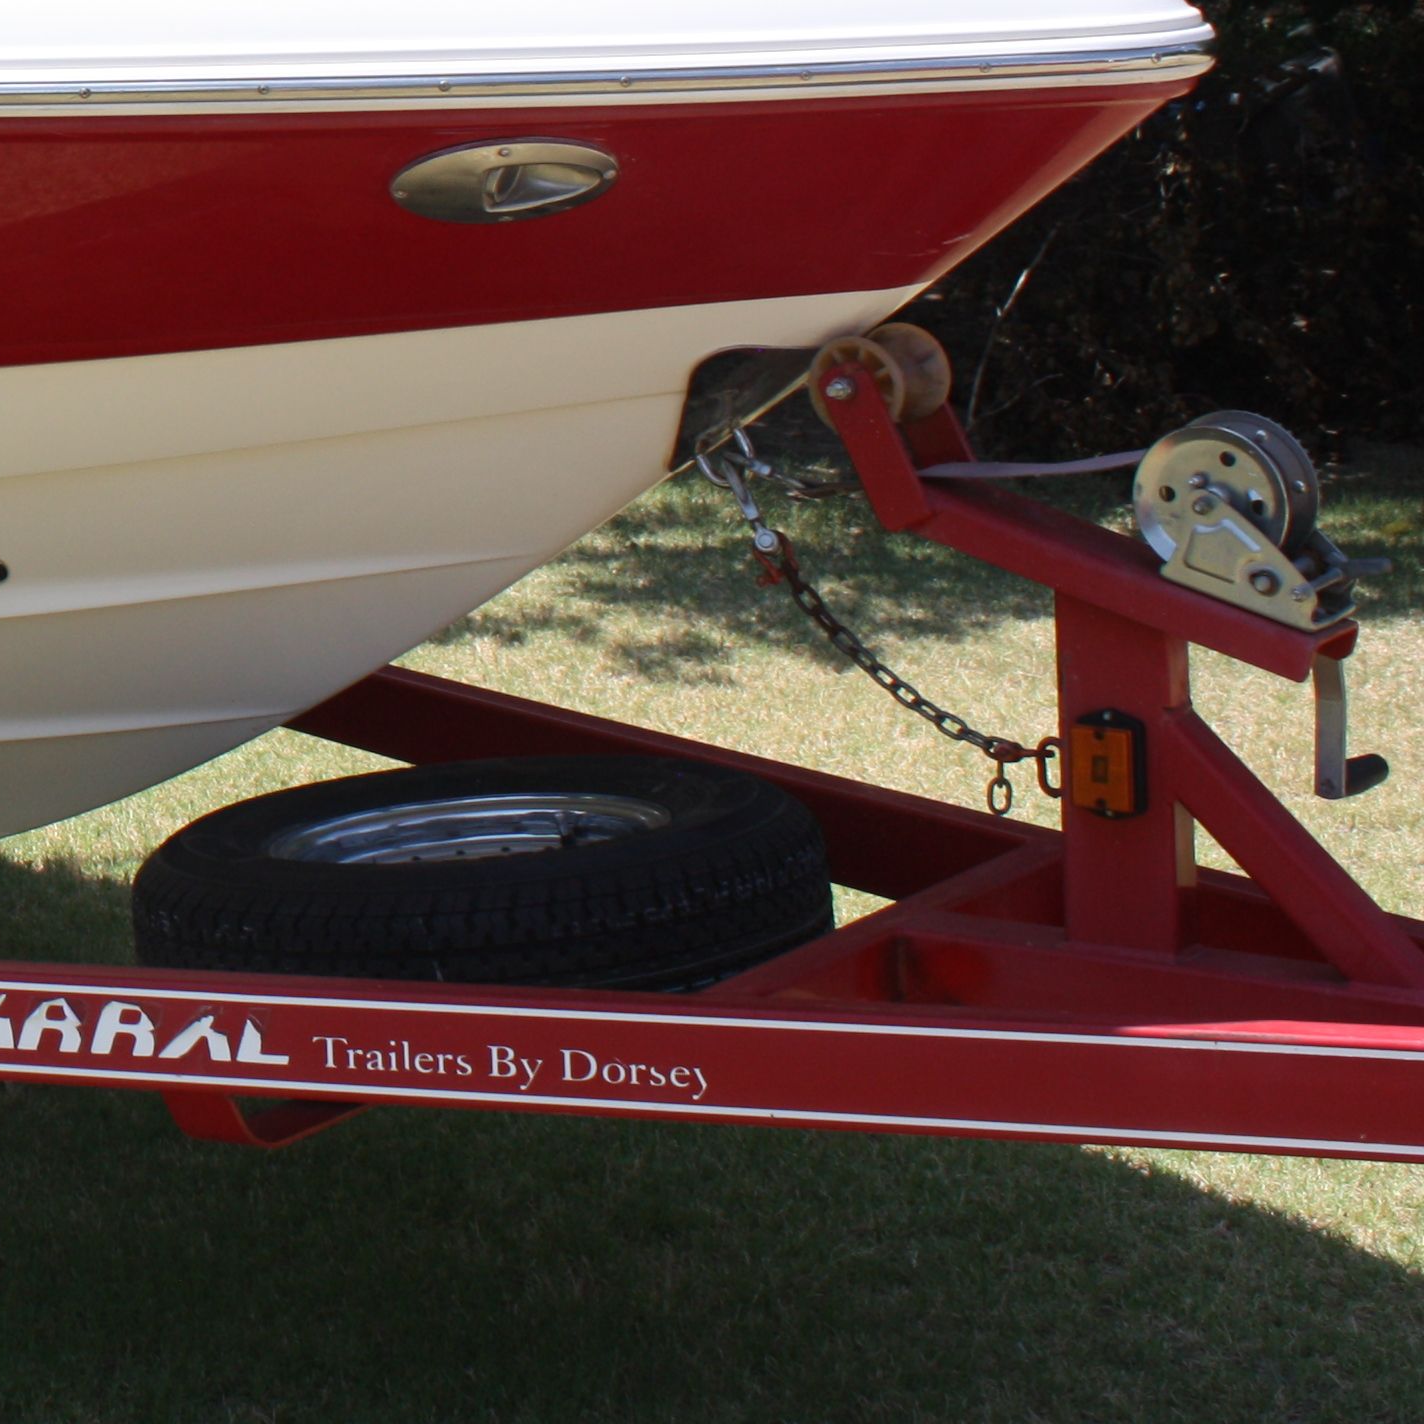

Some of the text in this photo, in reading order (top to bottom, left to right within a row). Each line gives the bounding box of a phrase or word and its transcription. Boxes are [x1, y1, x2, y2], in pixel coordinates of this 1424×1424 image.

[312, 1035, 472, 1077] Trailers
[487, 1045, 543, 1091] By
[561, 1049, 708, 1100] Dorsey
